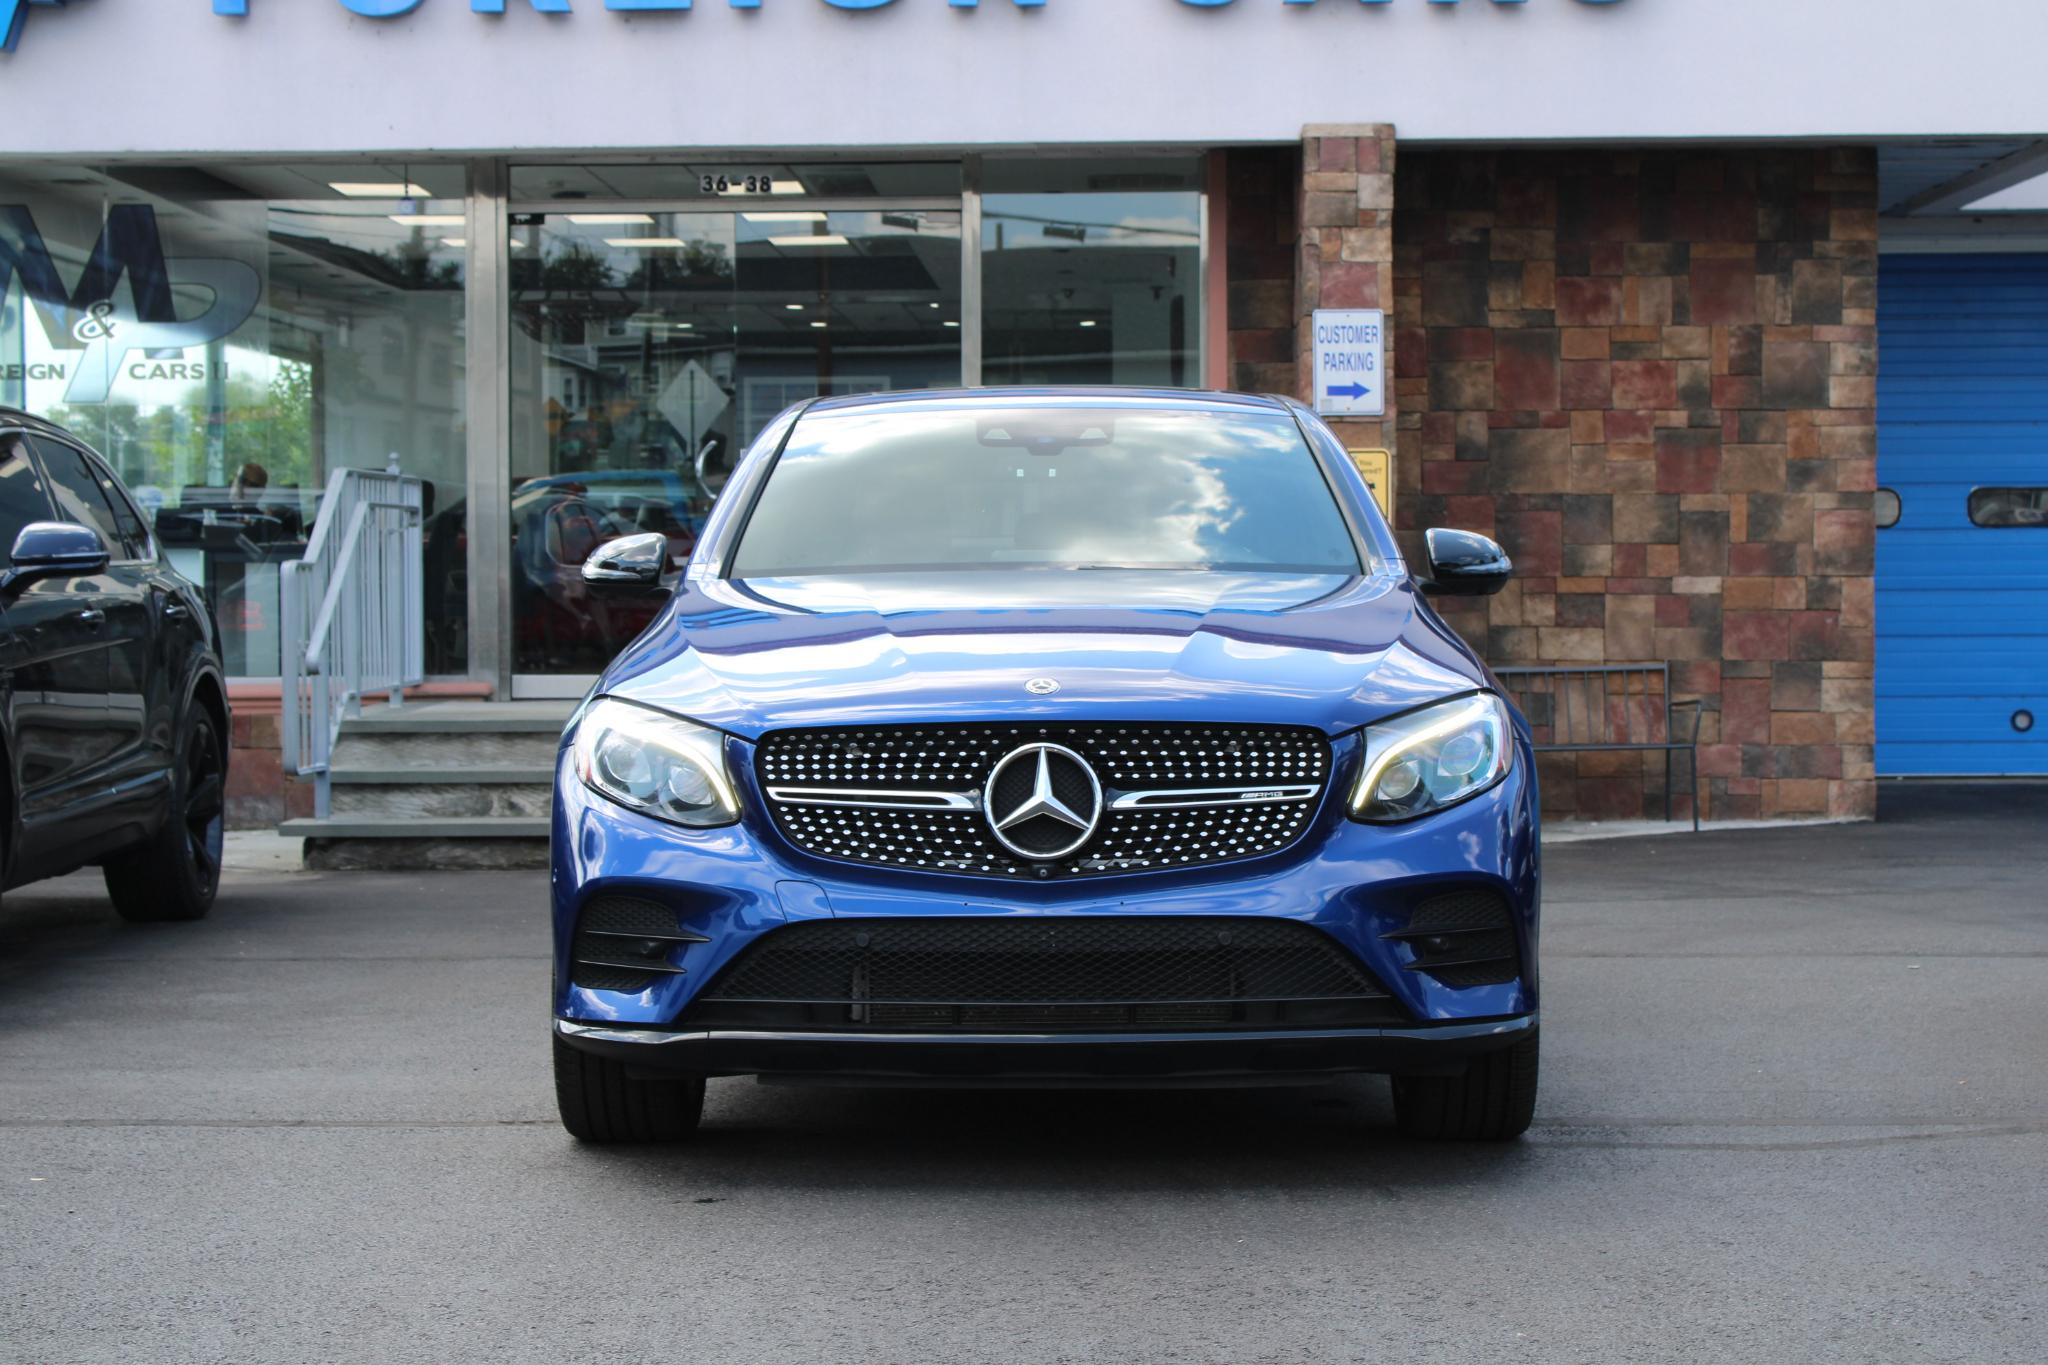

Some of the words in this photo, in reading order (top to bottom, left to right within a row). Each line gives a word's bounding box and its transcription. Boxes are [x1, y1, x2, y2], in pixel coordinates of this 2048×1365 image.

[702, 175, 772, 193] 36-38
[1318, 325, 1379, 345] CUSTOMER
[129, 363, 205, 380] CARS
[1323, 352, 1375, 372] PARKING
